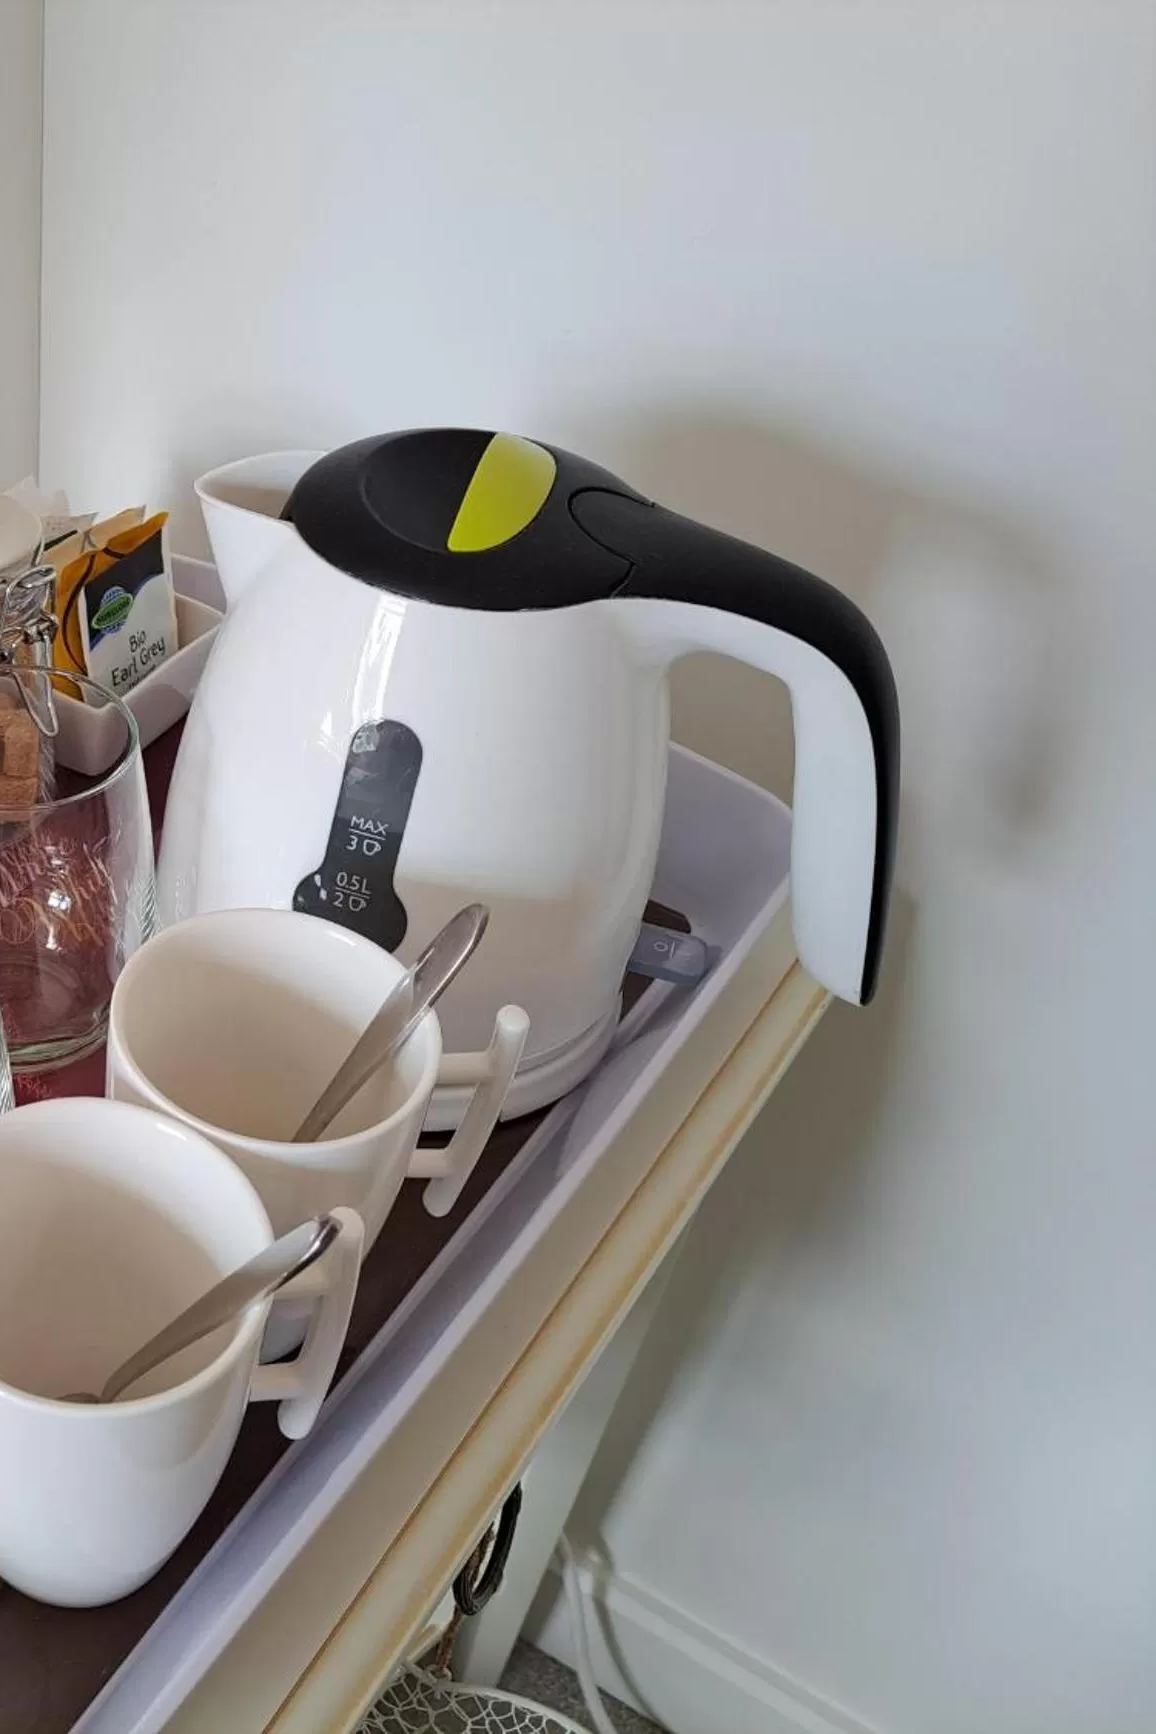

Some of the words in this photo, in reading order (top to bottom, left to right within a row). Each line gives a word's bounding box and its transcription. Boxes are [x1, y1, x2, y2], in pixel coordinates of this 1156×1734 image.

[129, 630, 146, 653] Bio
[112, 656, 139, 687] Earl
[140, 636, 166, 665] Grey
[349, 815, 389, 836] MAX
[346, 835, 359, 851] 3
[332, 892, 344, 908] 2
